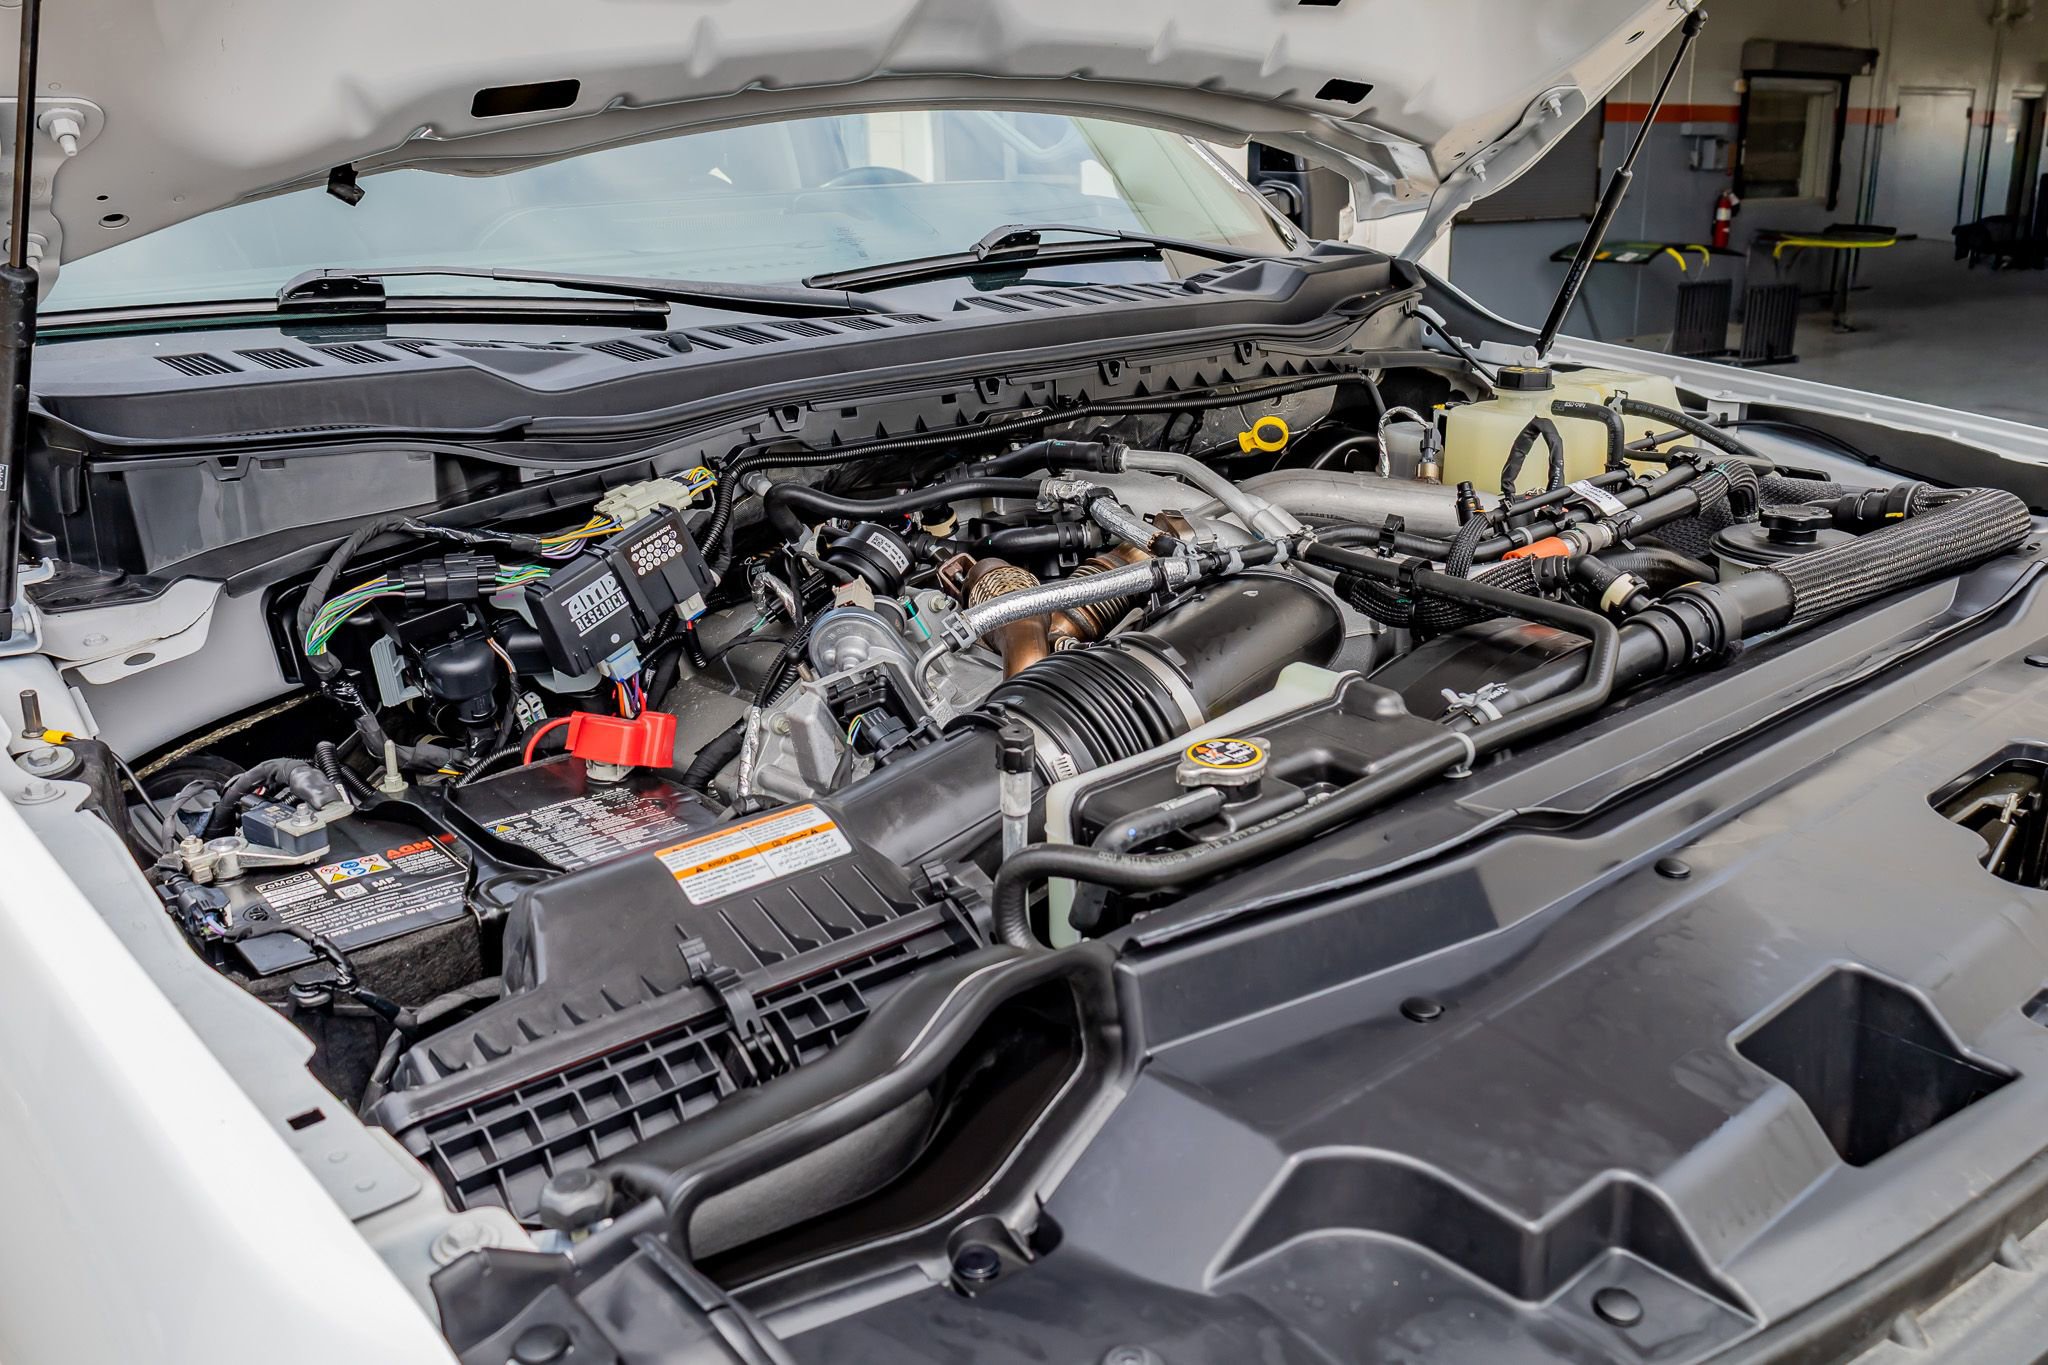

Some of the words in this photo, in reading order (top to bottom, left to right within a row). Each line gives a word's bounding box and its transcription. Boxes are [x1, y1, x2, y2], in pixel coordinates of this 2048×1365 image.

[630, 541, 642, 553] AMP
[642, 524, 672, 545] RESEARCH
[565, 572, 620, 621] AMP
[575, 590, 628, 632] RESEARCH
[387, 840, 434, 859] AGM
[258, 874, 310, 891] FoMoCo
